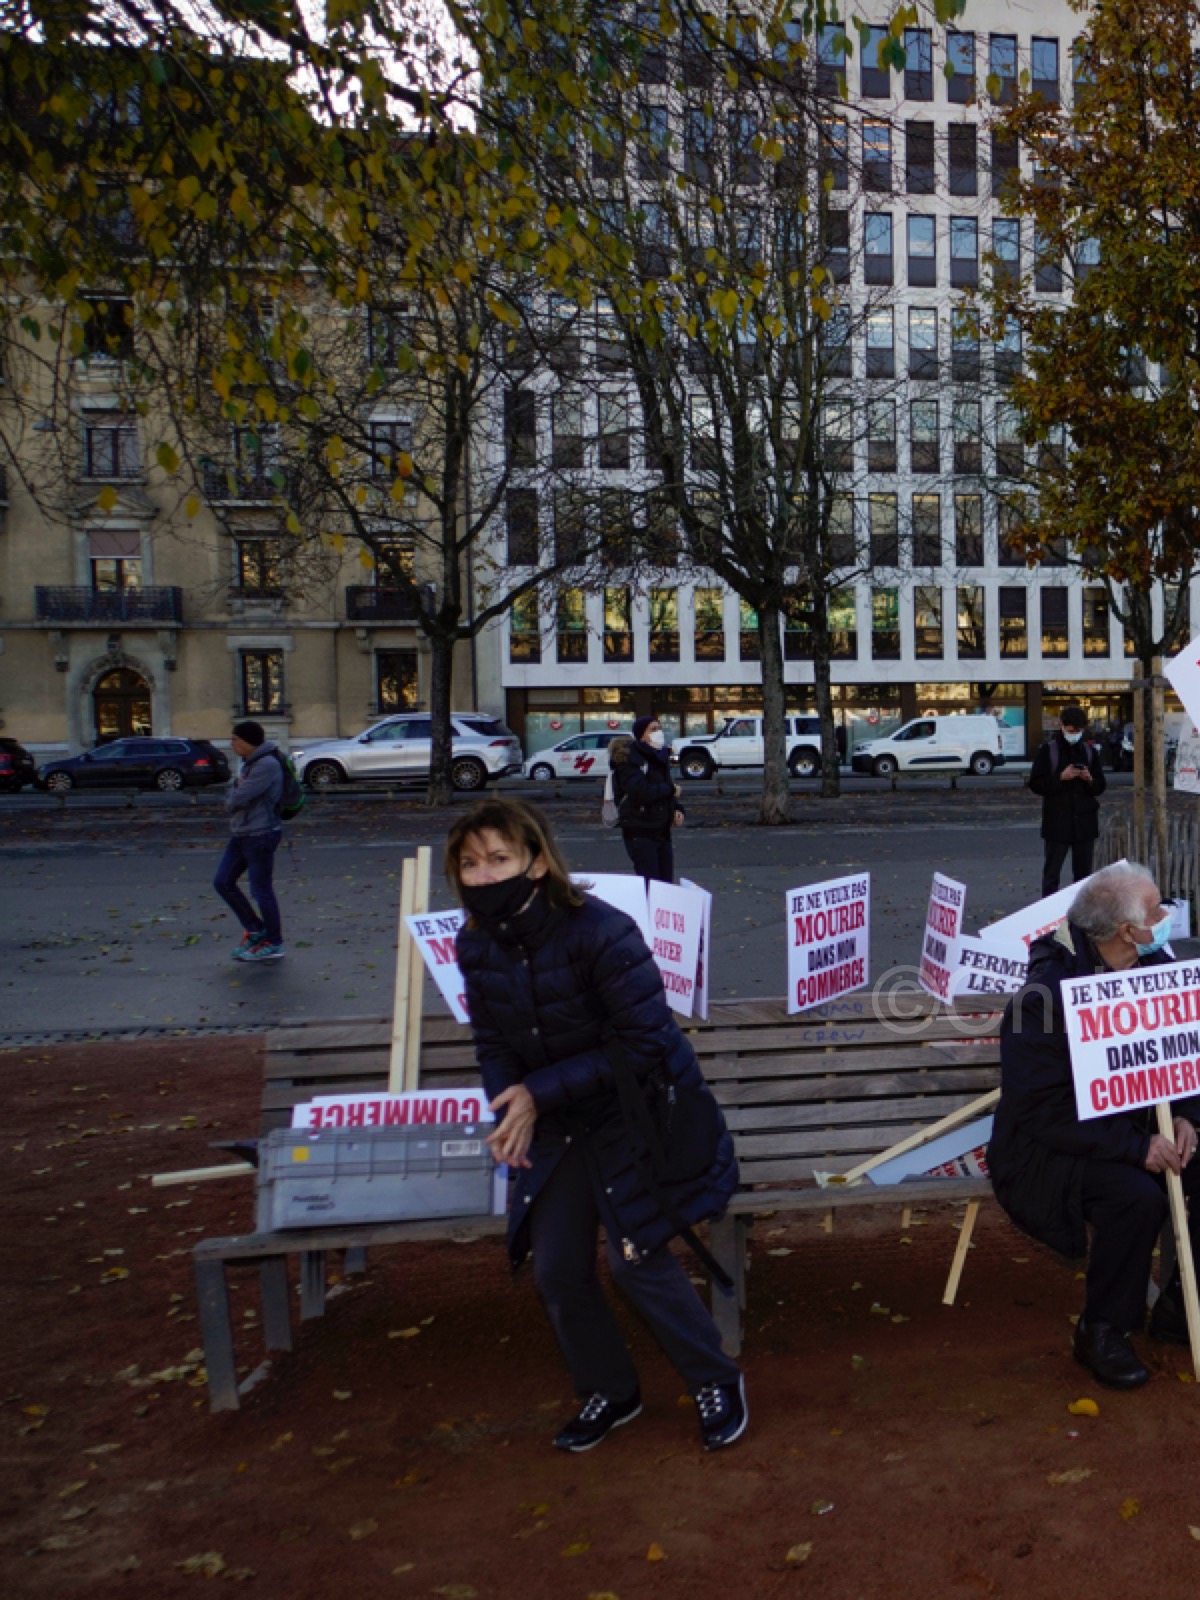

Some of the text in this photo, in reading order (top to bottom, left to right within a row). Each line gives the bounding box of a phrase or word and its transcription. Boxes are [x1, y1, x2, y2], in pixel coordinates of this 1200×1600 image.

[792, 895, 804, 915] JE
[806, 892, 822, 910] NE
[851, 880, 867, 898] PAS
[654, 908, 685, 934] QUI VA
[794, 900, 865, 946] MOURIR
[653, 936, 682, 962] PAYER
[808, 936, 857, 972] DANS MON
[796, 957, 864, 1007] COMMERCE
[967, 973, 1006, 993] LES
[1070, 984, 1092, 1006] JE
[1097, 979, 1124, 1000] NE
[1128, 970, 1179, 995] VEUX
[1106, 1030, 1200, 1071] DANS MON
[309, 1097, 480, 1128] COMMERCE
